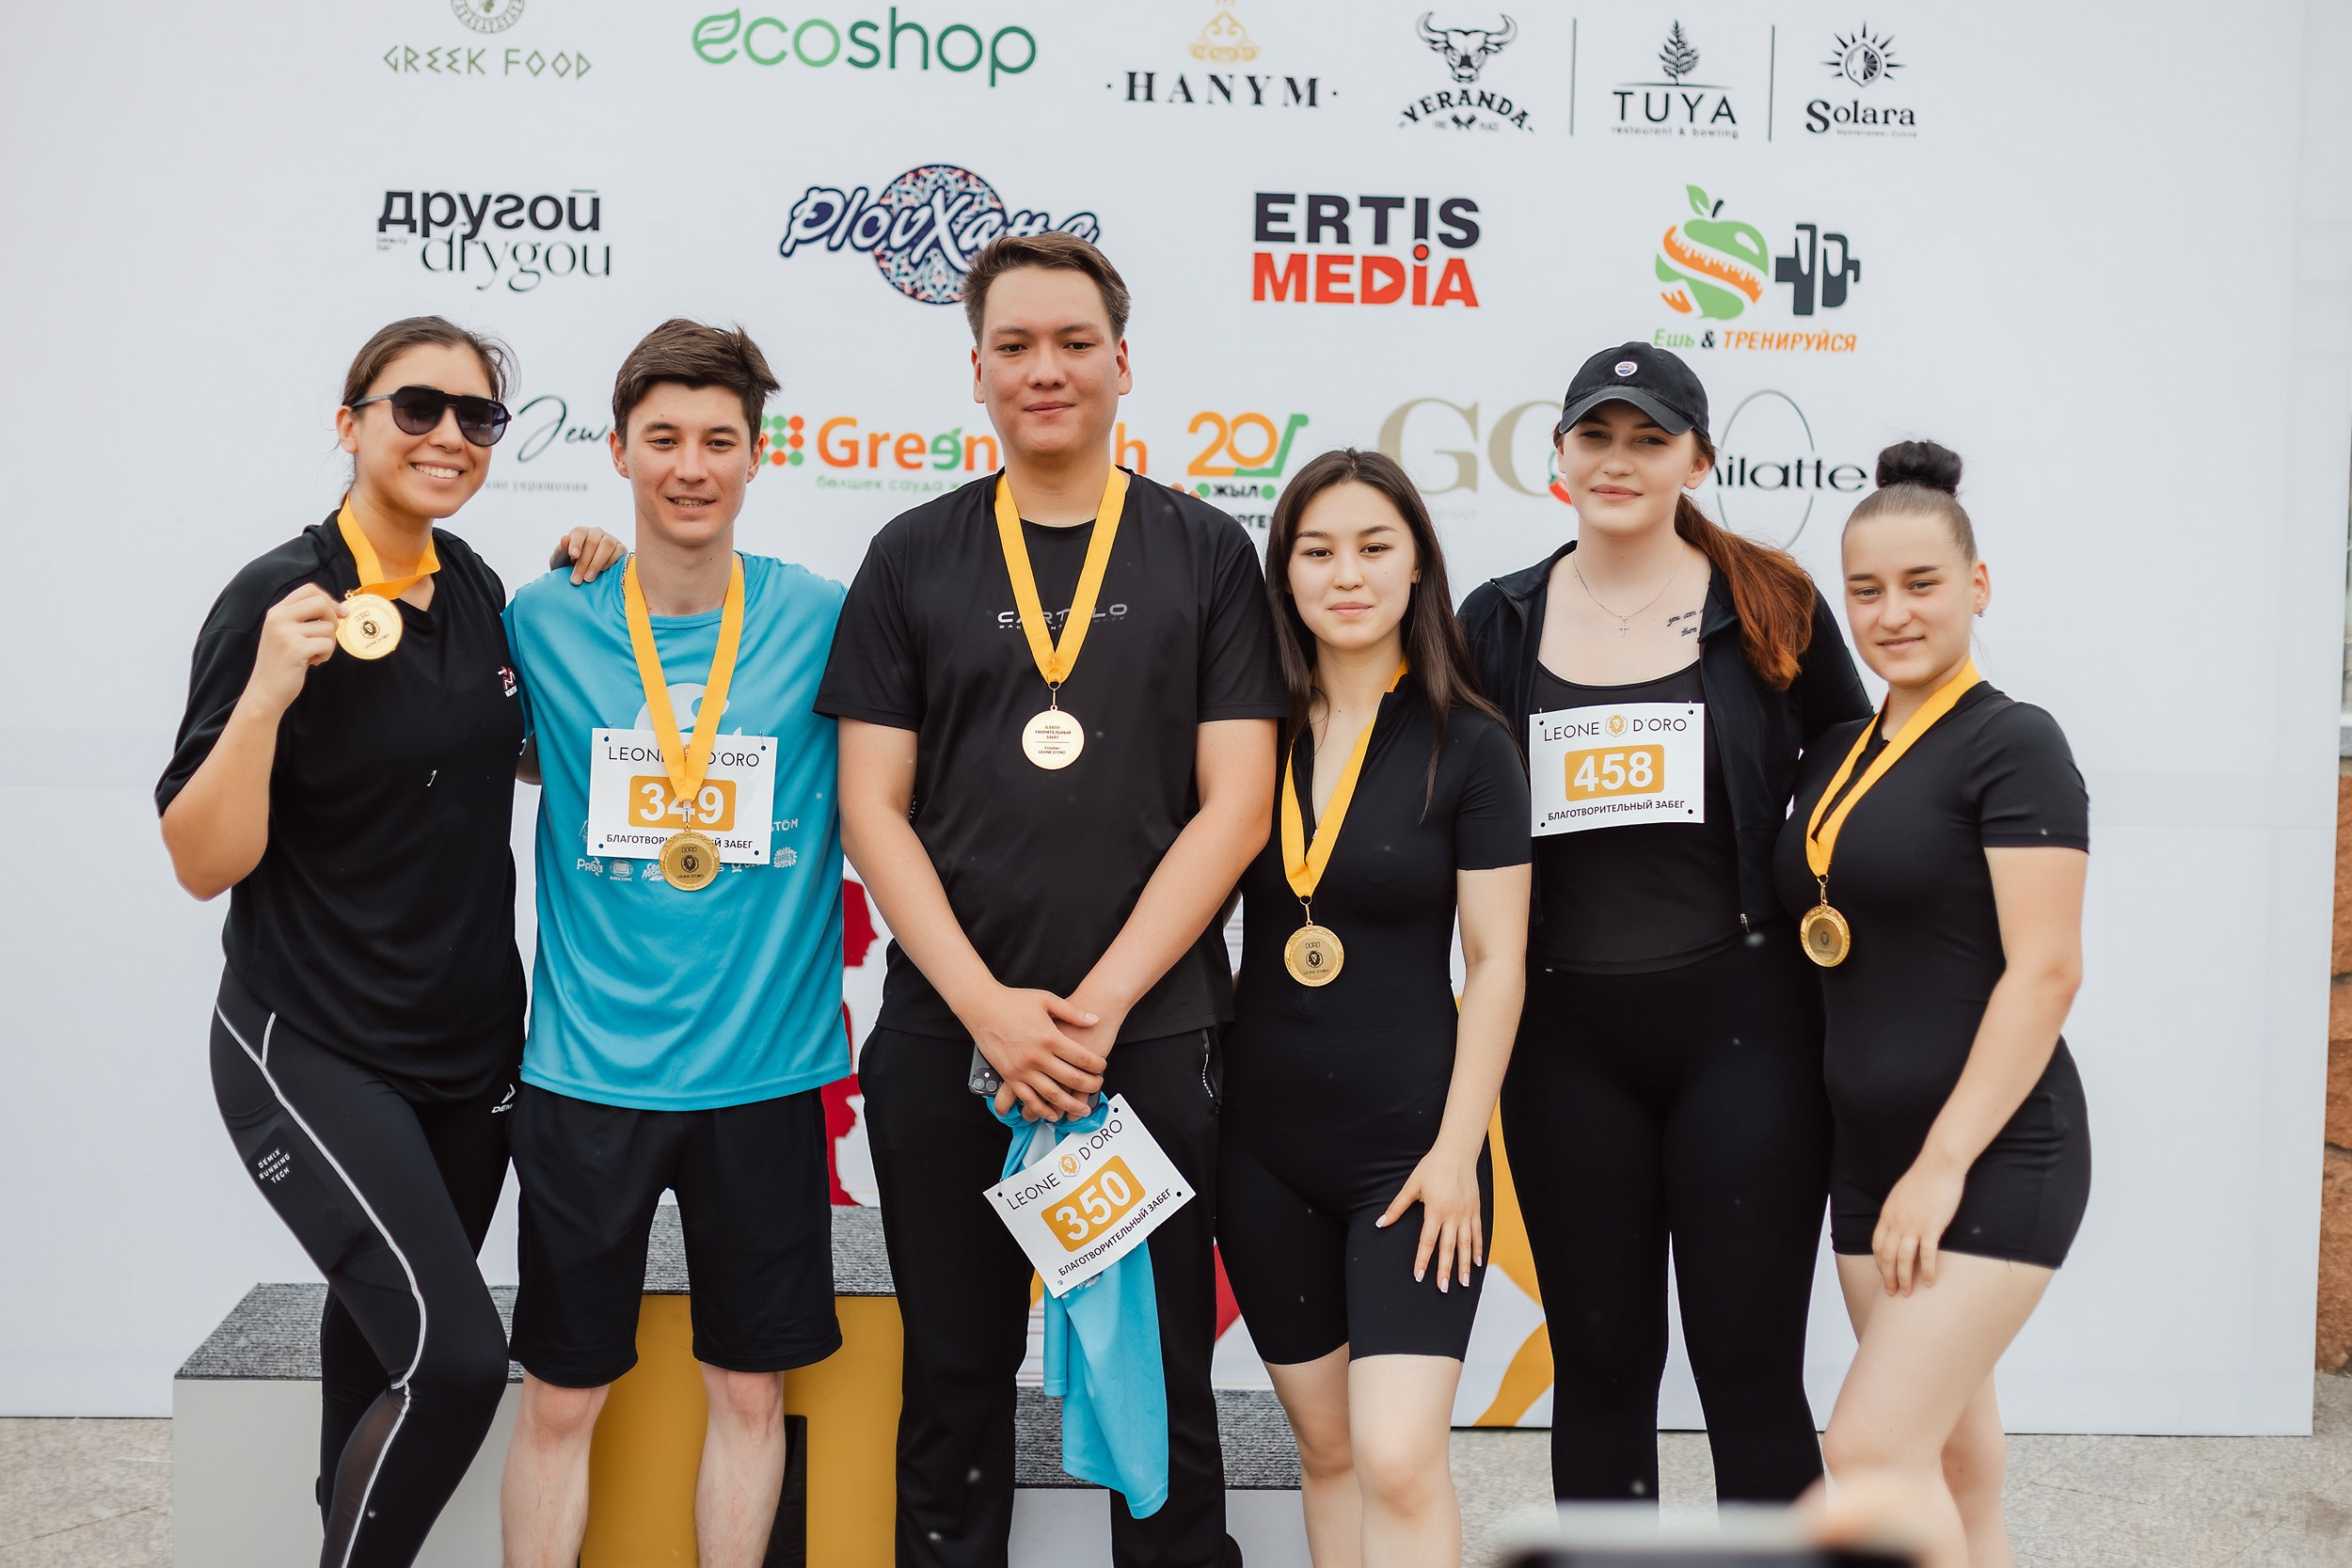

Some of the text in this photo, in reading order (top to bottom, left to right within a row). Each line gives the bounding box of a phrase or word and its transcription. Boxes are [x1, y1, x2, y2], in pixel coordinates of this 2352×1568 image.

[384, 45, 591, 78] GREEK FOOD
[691, 7, 1036, 87] ecoshop
[1125, 71, 1319, 107] HANYM
[1613, 91, 1737, 124] TUYA
[1403, 89, 1531, 129] VERANDA
[1806, 99, 1915, 133] Solara
[377, 189, 599, 241] другой
[1254, 192, 1480, 248] ERTIS
[421, 222, 610, 293] drygou
[1653, 329, 1858, 353] Ешь & ТРЕНИРУЙСЯ
[1187, 411, 1279, 478] 20
[1544, 718, 1687, 741] LEONE D'ORO
[1573, 751, 1654, 792] 458
[639, 783, 724, 824] 349
[1548, 800, 1686, 821] БЛАГОТВОРИТЕЛЬНЫЙ ЗАБЕГ
[723, 839, 753, 849] ЗАБЕГ
[258, 1148, 280, 1168] DEMIX
[259, 1152, 291, 1180] RUNNING
[271, 1167, 290, 1183] TECH
[1006, 1119, 1122, 1211] LEONE D'ORO
[1055, 1170, 1132, 1241] 350
[1057, 1187, 1172, 1276] БЛАГОТВОРИТЕЛЬНЫЙ ЗАБЕГ
